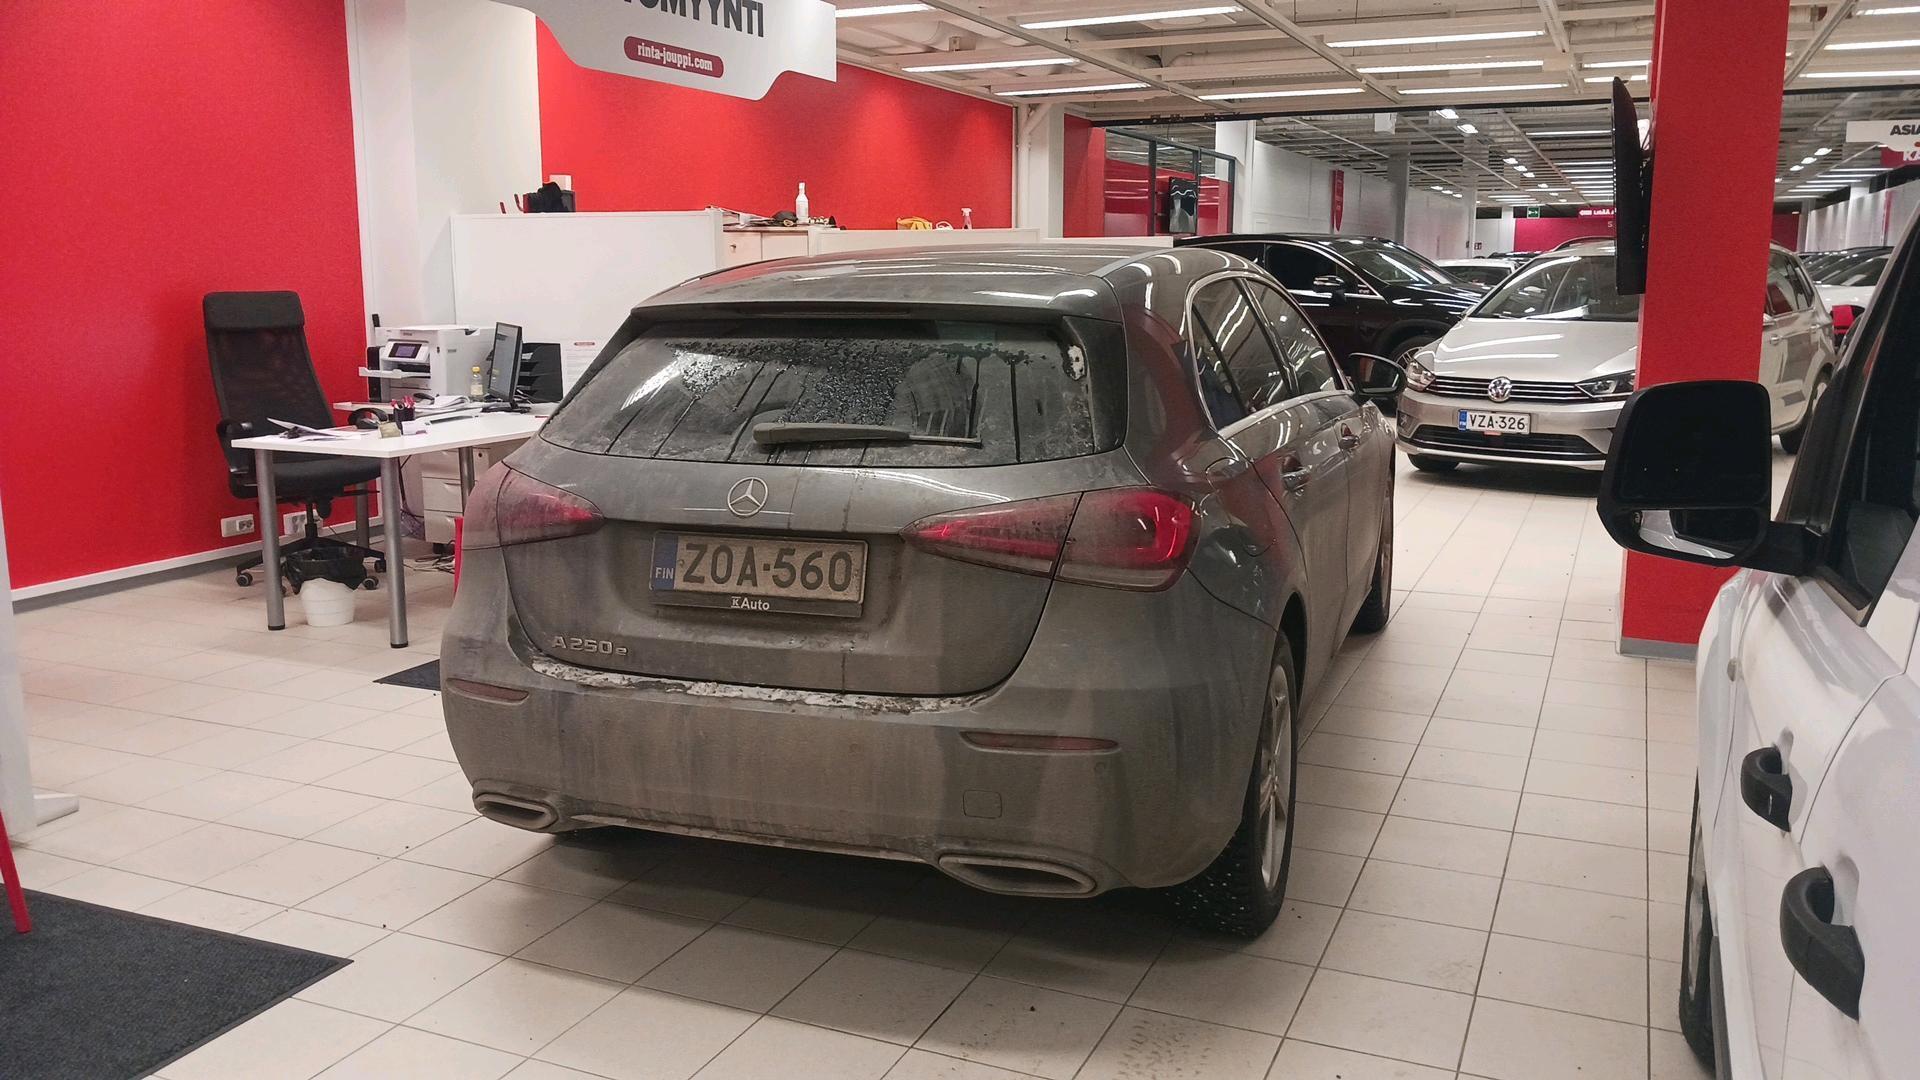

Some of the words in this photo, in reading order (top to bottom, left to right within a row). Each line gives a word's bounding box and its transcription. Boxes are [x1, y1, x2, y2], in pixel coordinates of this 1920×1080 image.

[624, 0, 764, 38] YYNTI
[637, 42, 713, 71] rinta-jouppi.com
[1469, 414, 1526, 430] VZA-326
[655, 566, 674, 579] FIN
[682, 543, 853, 592] ZOA-560
